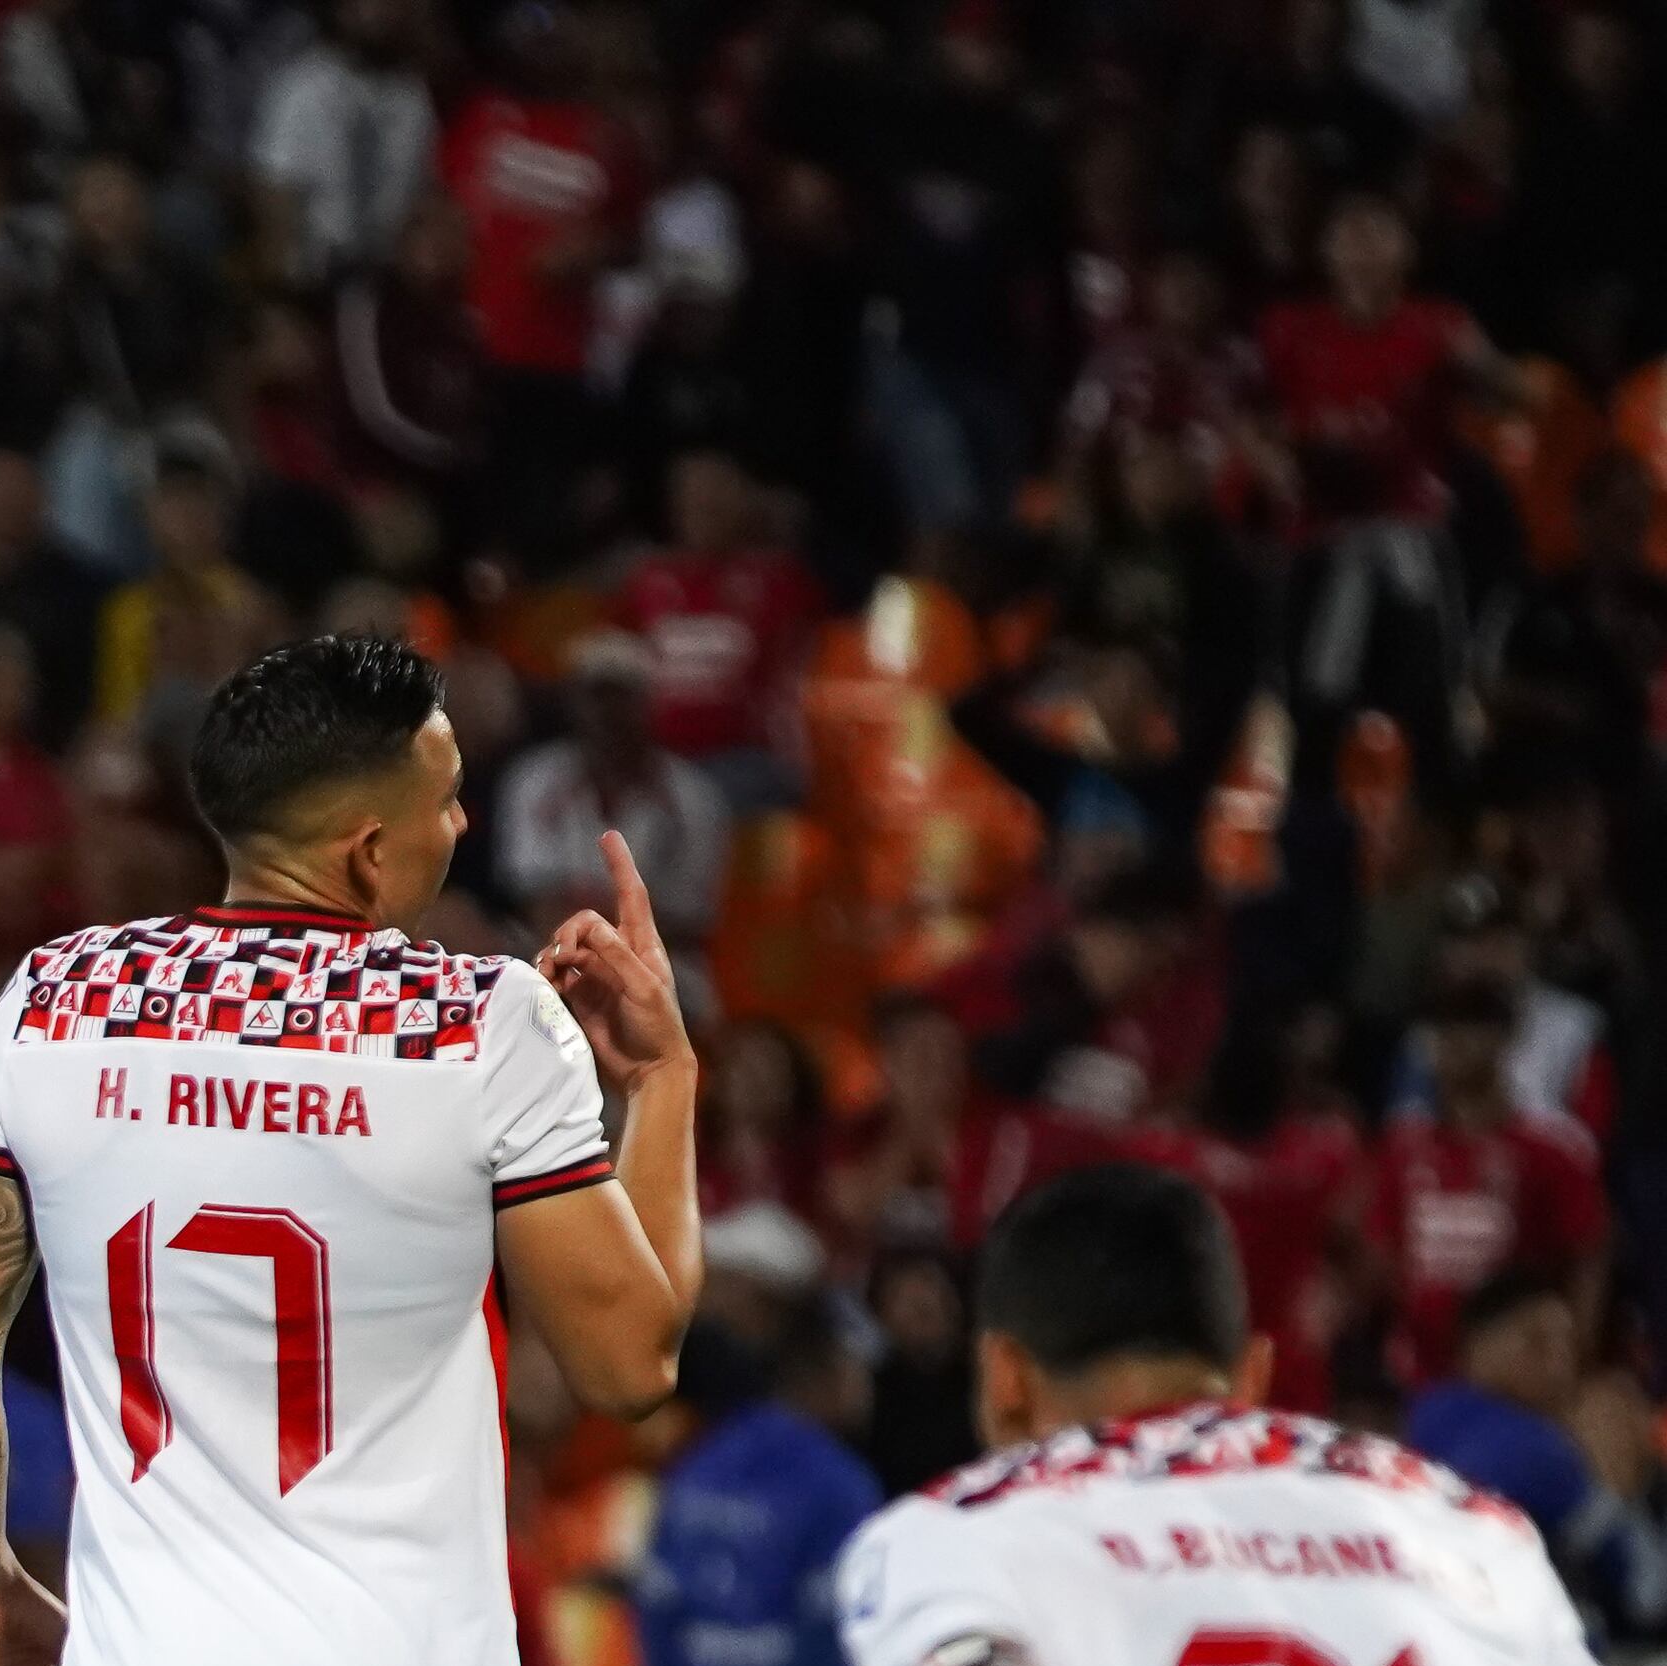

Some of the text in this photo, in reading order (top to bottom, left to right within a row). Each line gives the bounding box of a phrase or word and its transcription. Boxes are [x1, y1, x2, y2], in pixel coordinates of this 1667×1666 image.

[96, 1067, 373, 1137] H. RIVERA
[107, 1199, 335, 1498] 17
